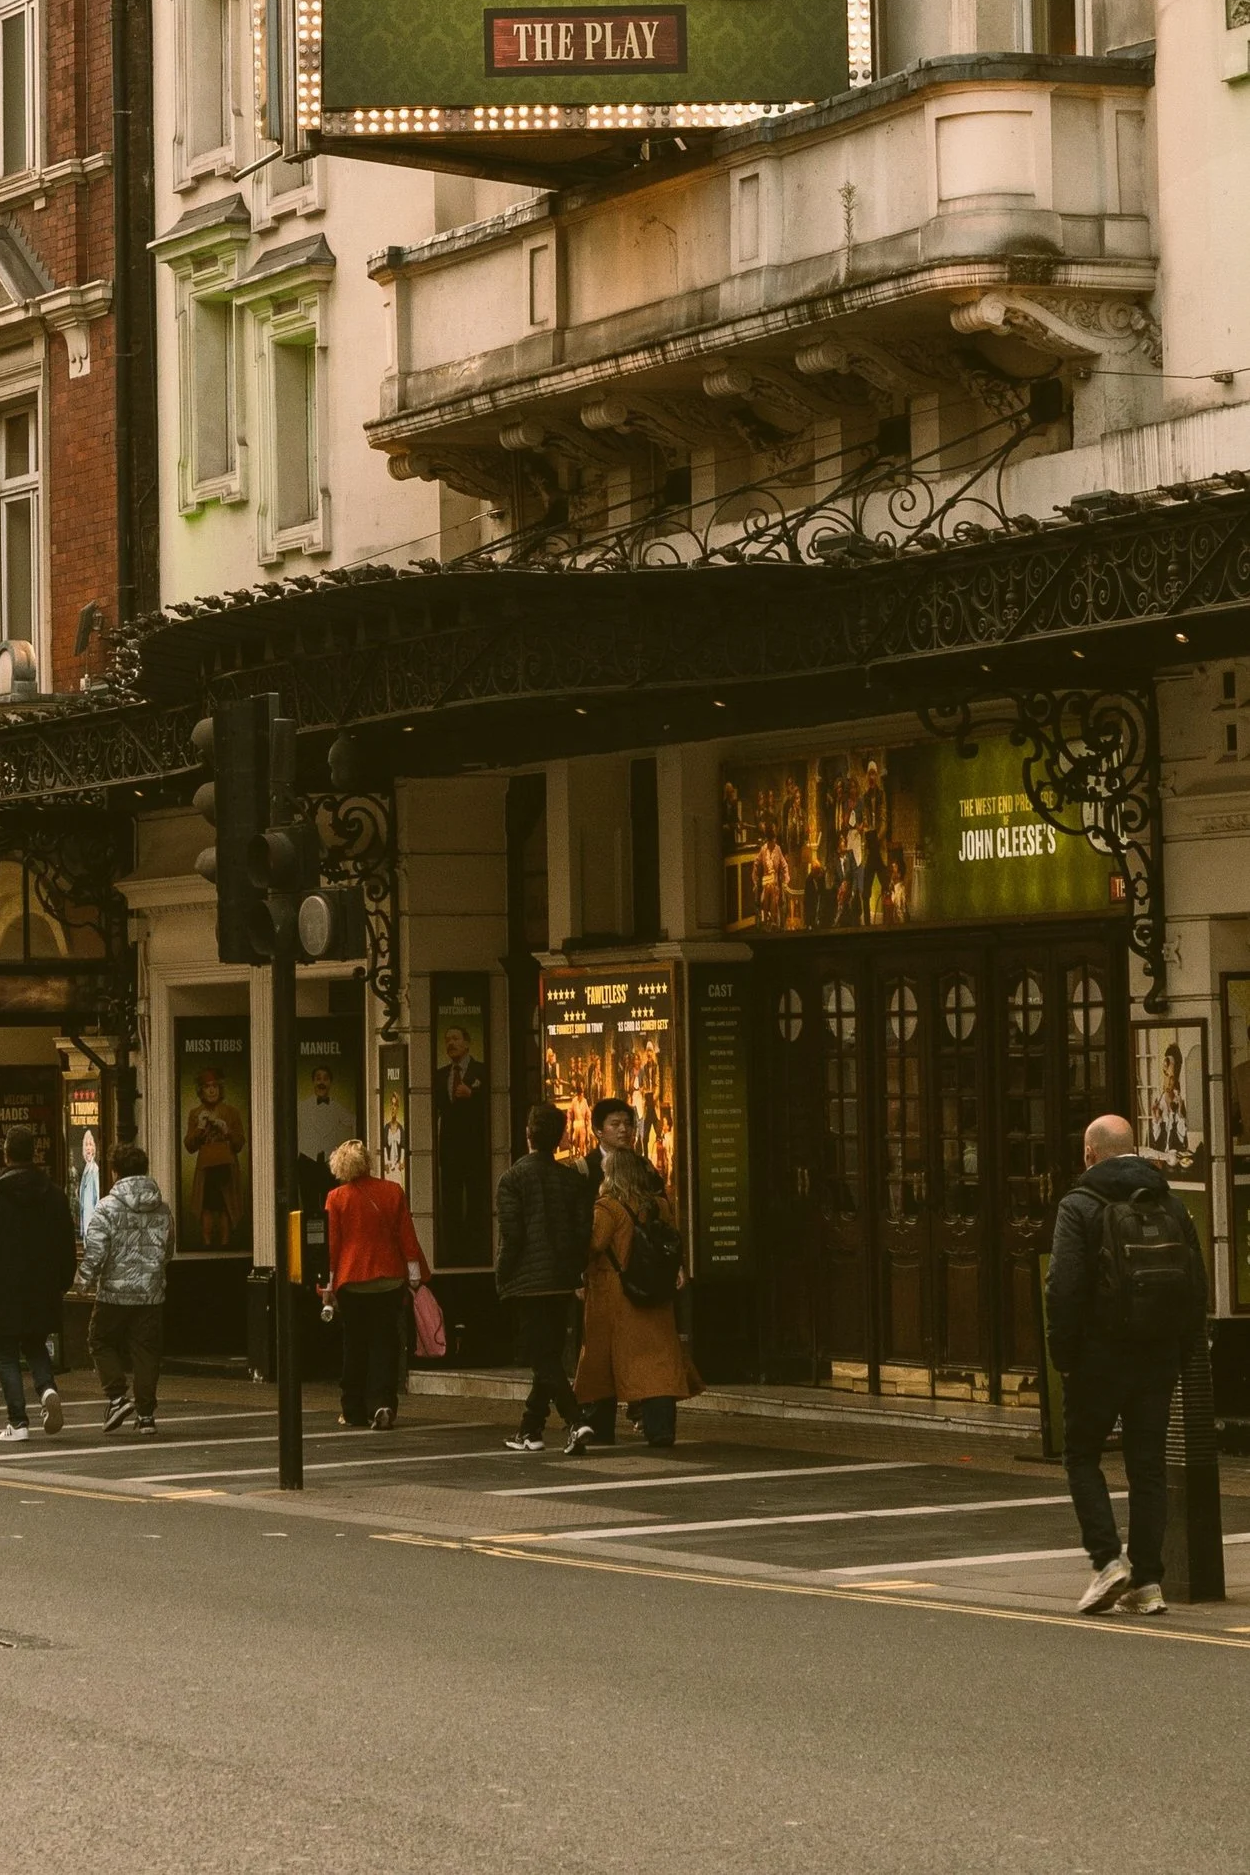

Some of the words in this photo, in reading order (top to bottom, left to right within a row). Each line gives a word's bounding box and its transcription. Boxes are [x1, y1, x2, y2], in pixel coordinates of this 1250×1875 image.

[513, 23, 575, 62] THE
[583, 20, 659, 61] PLAY
[959, 799, 973, 817] THE
[974, 796, 996, 817] WEST
[997, 794, 1013, 814] END
[958, 829, 993, 862] JOHN
[708, 983, 734, 998] CAST
[185, 1039, 211, 1053] MISS
[213, 1038, 242, 1052] TIBBS
[300, 1041, 342, 1055] MANUEL
